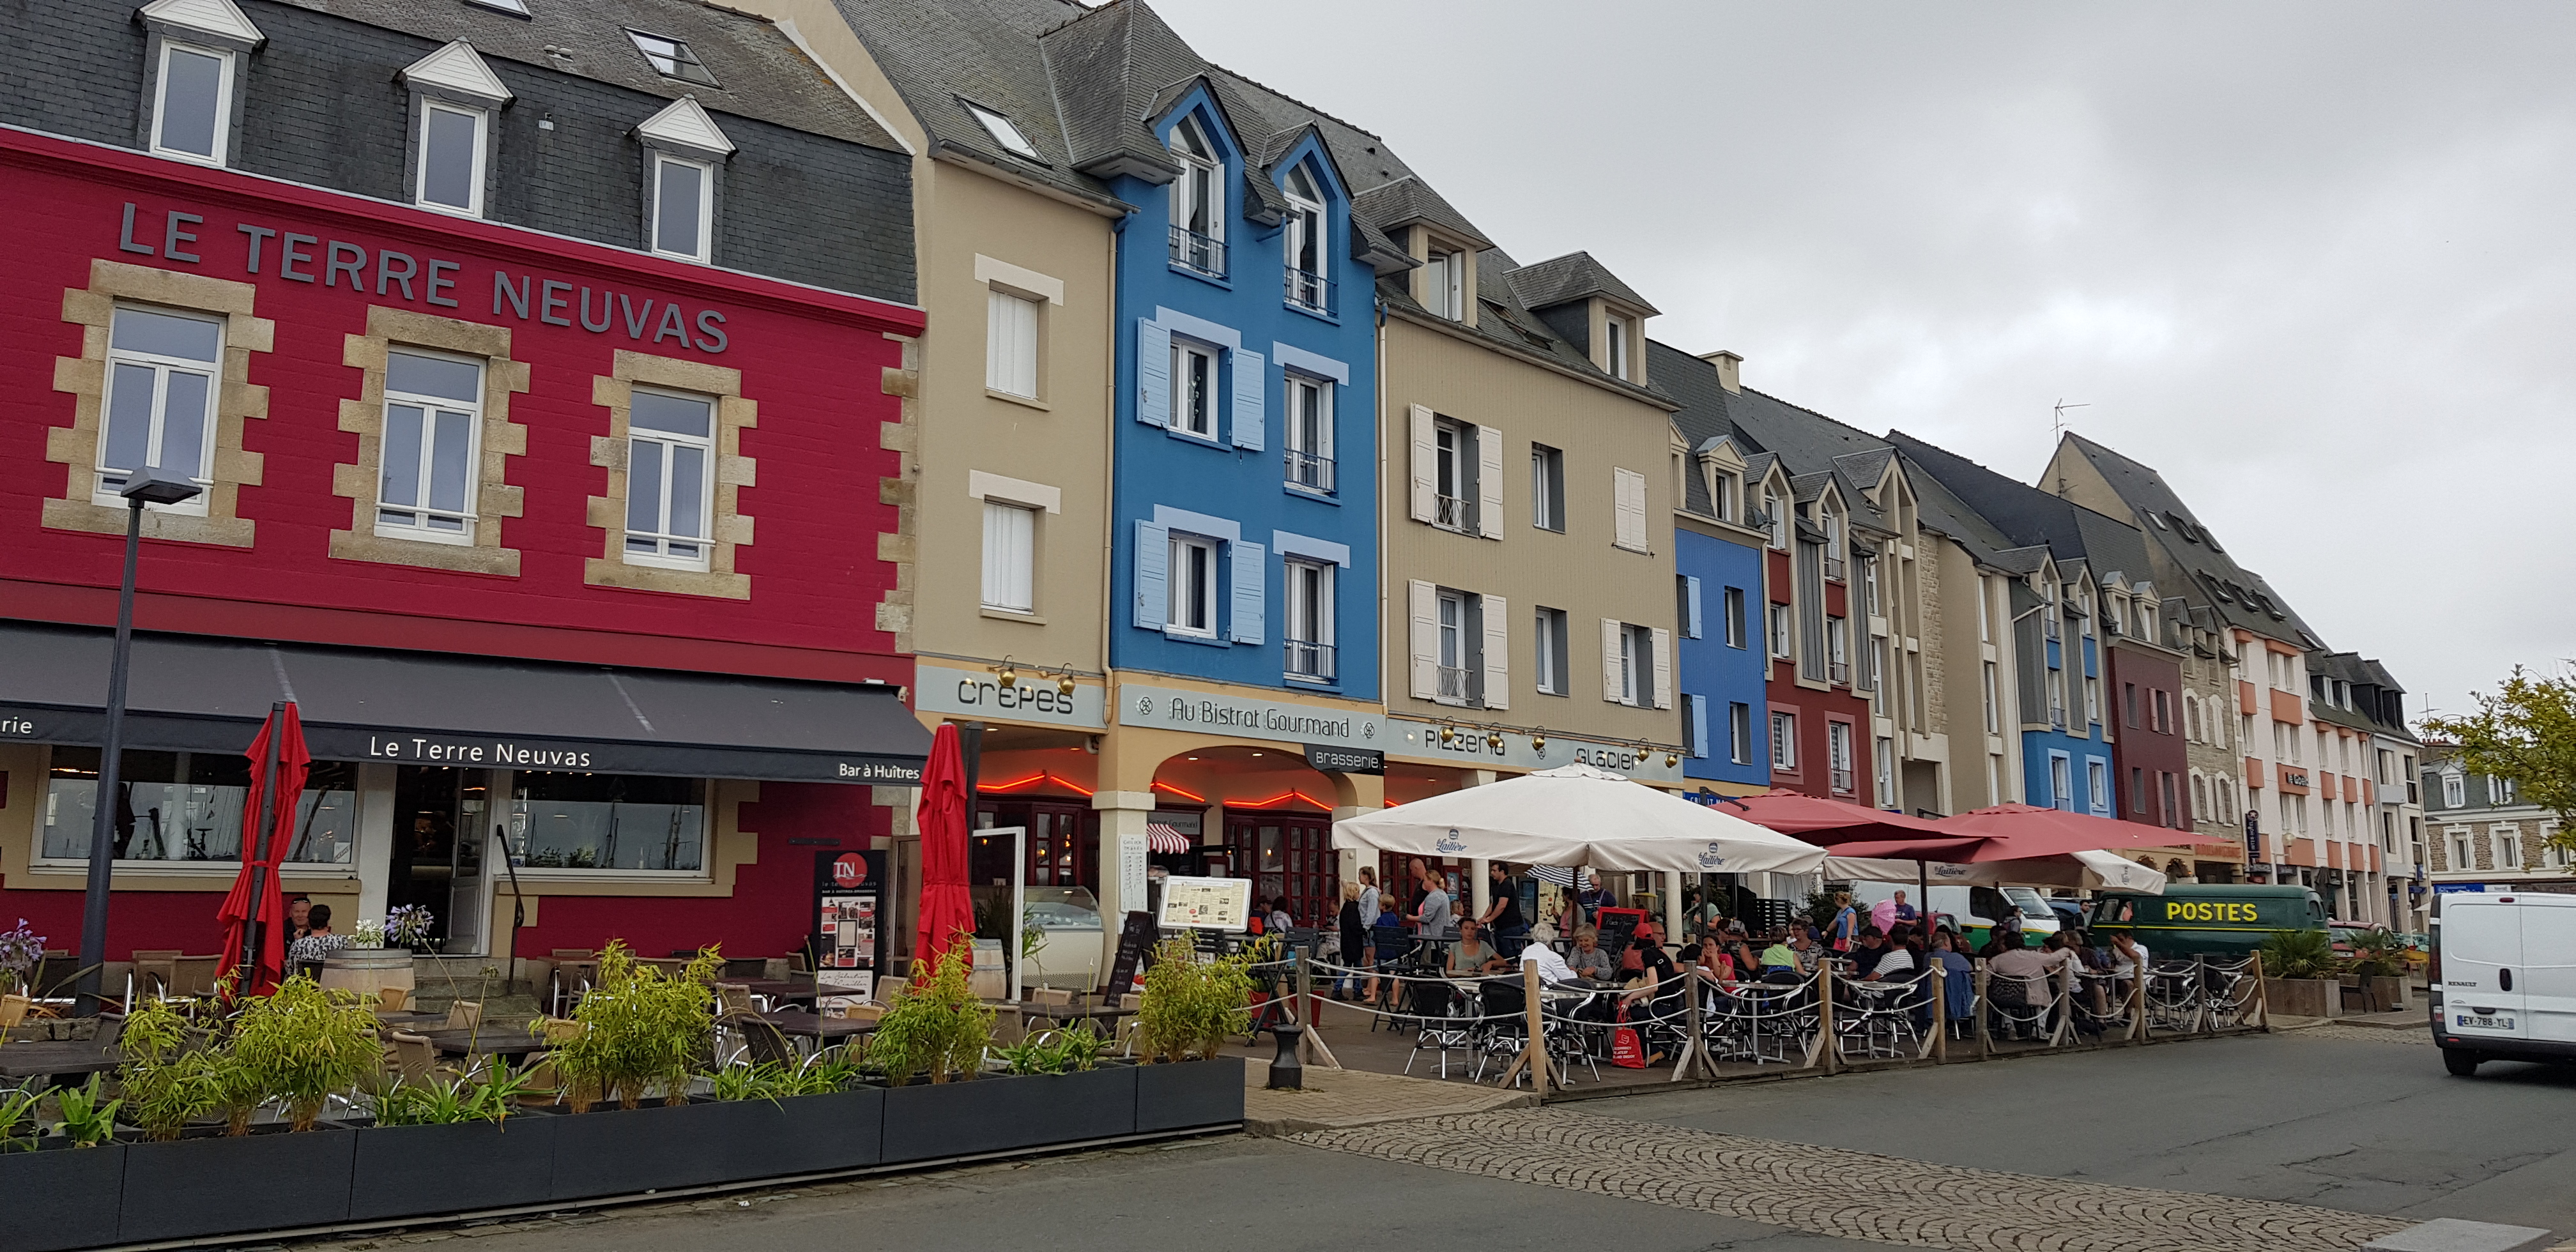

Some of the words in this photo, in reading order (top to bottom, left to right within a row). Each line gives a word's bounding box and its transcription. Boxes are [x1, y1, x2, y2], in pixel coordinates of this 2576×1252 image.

[119, 202, 203, 263] LE
[237, 223, 460, 307] TERRE
[493, 271, 728, 353] NEUVAS
[2, 716, 33, 734] rie
[1171, 698, 1195, 721] Au
[1200, 701, 1260, 728] Bistrot
[1266, 708, 1349, 738] Gourmand
[370, 736, 399, 758] Le
[412, 738, 484, 762] Terre
[496, 744, 591, 767] Neuvas
[1316, 751, 1379, 769] Brasserie
[1576, 748, 1638, 771] Glacier
[839, 763, 861, 777] Bar
[863, 763, 871, 777] à
[874, 765, 920, 779] Huîtres
[2167, 902, 2258, 922] POSTES
